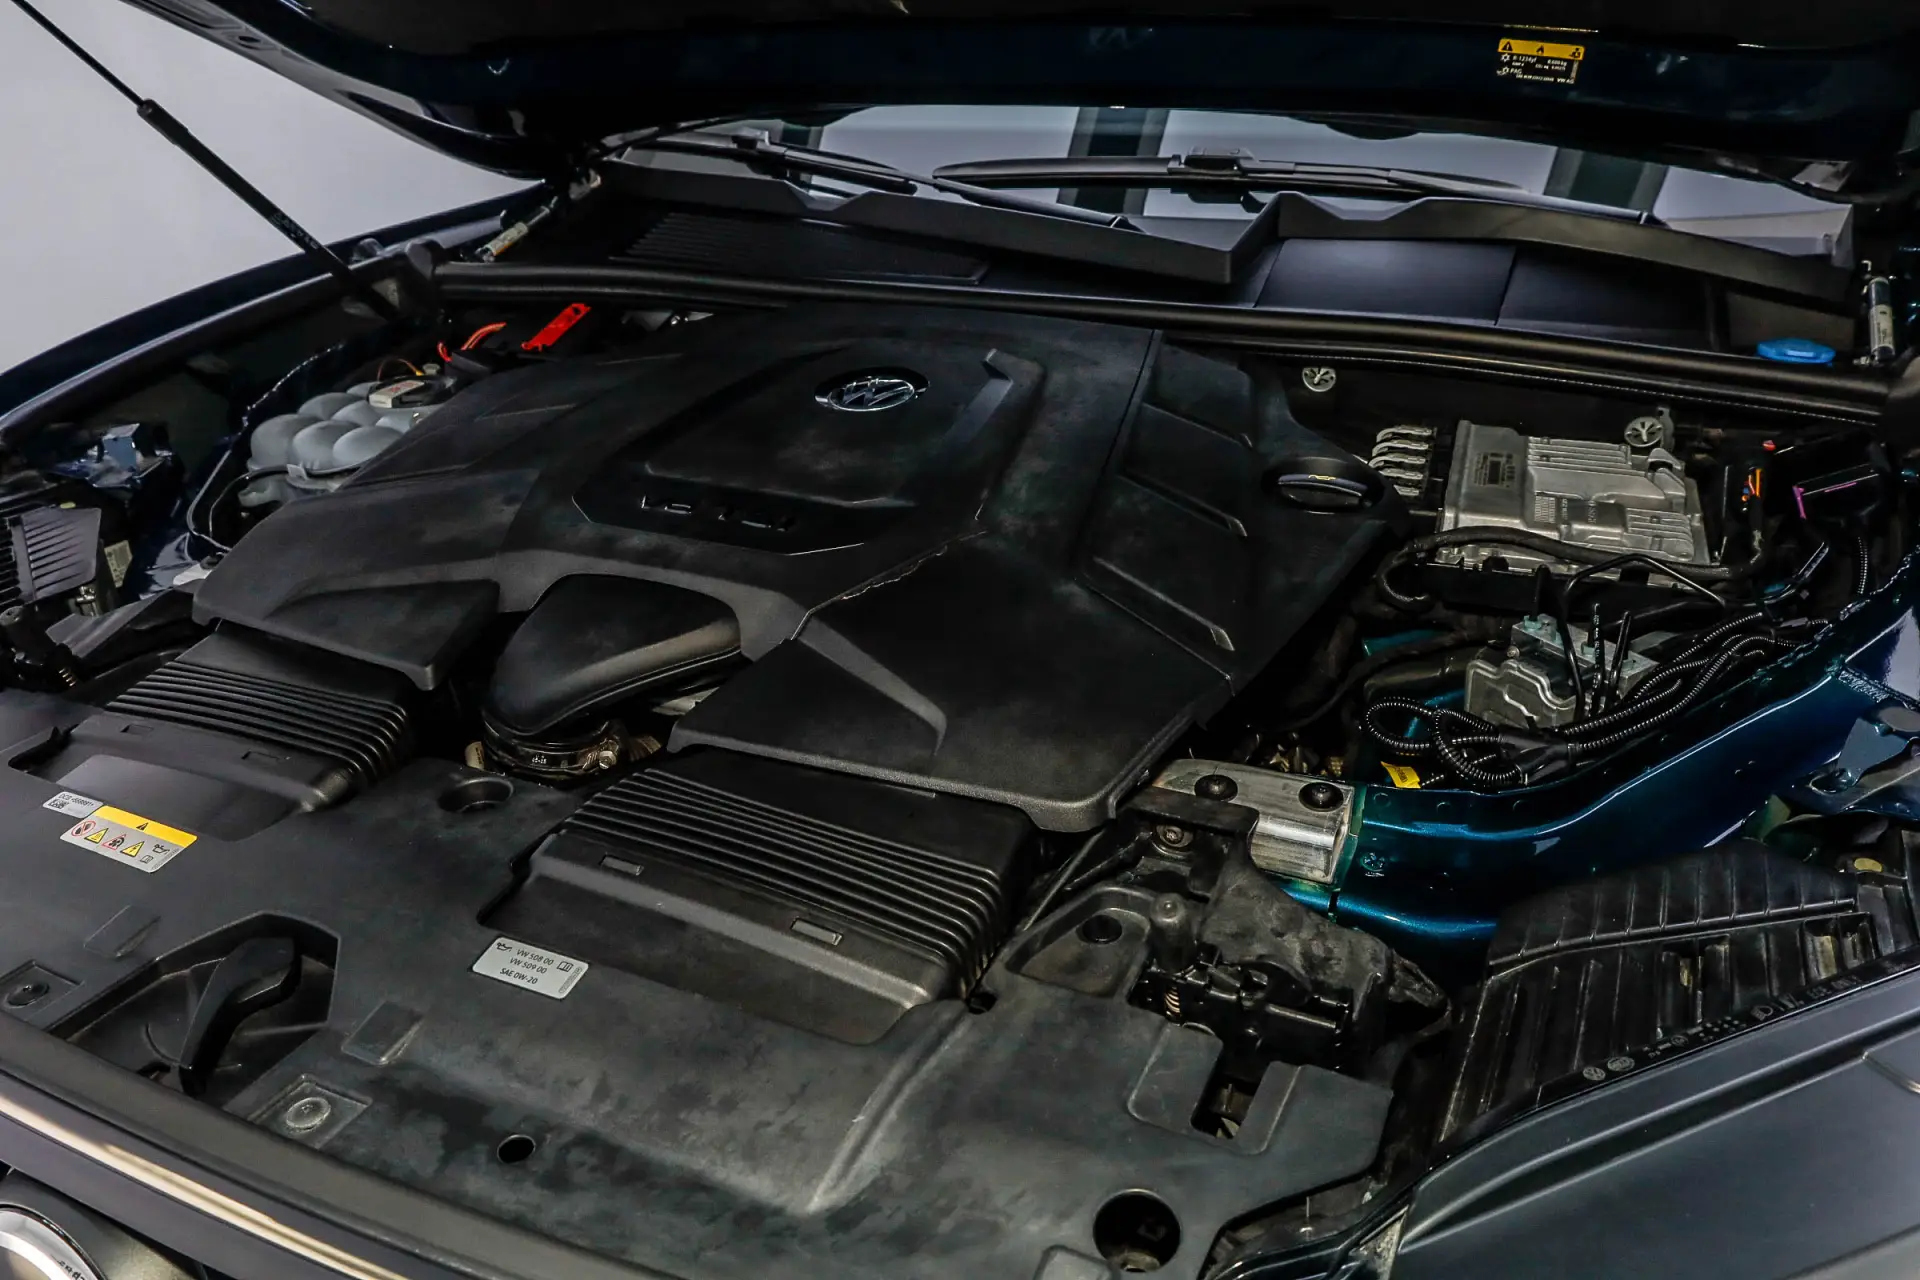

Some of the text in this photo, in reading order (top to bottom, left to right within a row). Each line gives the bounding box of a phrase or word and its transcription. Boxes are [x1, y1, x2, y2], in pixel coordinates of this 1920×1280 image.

[509, 957, 548, 974] VW 509 00
[516, 949, 554, 966] VW 508 00
[500, 967, 539, 985] SAE 0W-20
